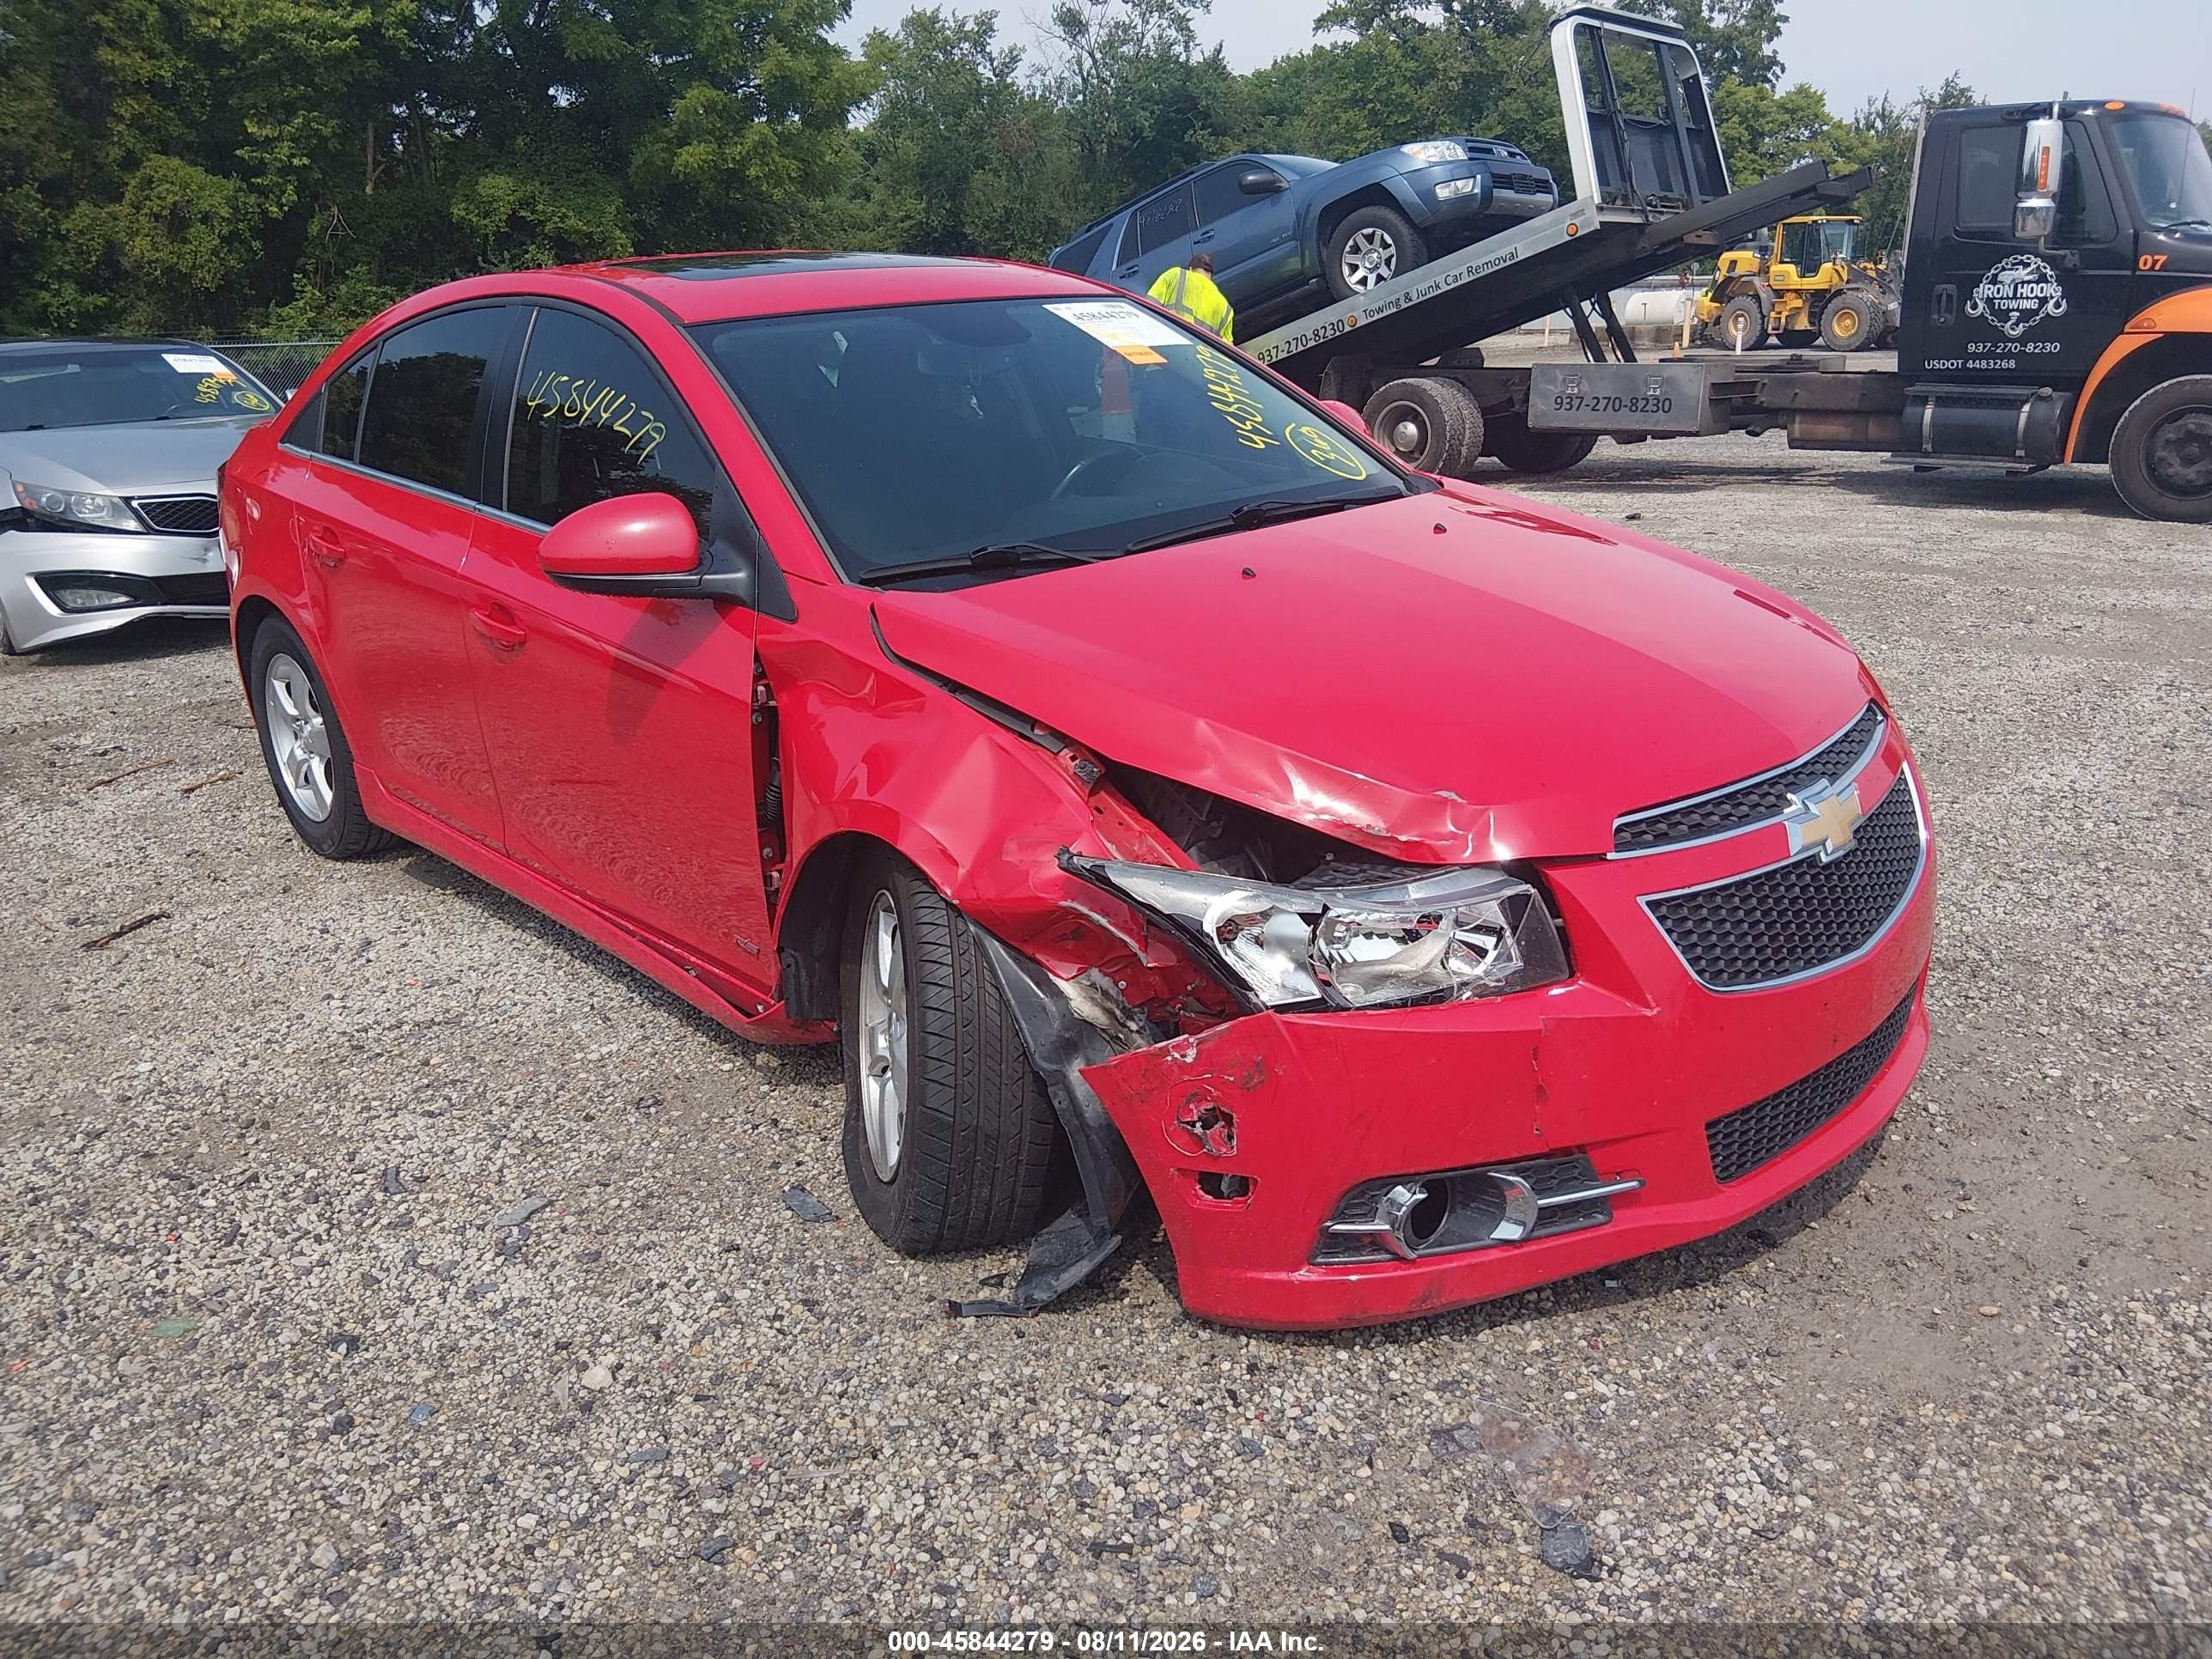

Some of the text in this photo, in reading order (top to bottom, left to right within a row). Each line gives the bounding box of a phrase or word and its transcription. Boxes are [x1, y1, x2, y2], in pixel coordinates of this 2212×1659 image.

[2138, 254, 2168, 271] 07
[1362, 246, 1520, 321] Towing & Junk Car Removal
[1978, 283, 2057, 299] IRON HOOK
[1992, 299, 2039, 310] TOWING
[1257, 319, 1346, 365] 937-270-8230
[1966, 342, 2061, 354] 937-270-8230
[1924, 359, 2016, 369] USDOT 4483268
[1553, 395, 1673, 414] 937-270-8230
[526, 370, 666, 465] 45844279
